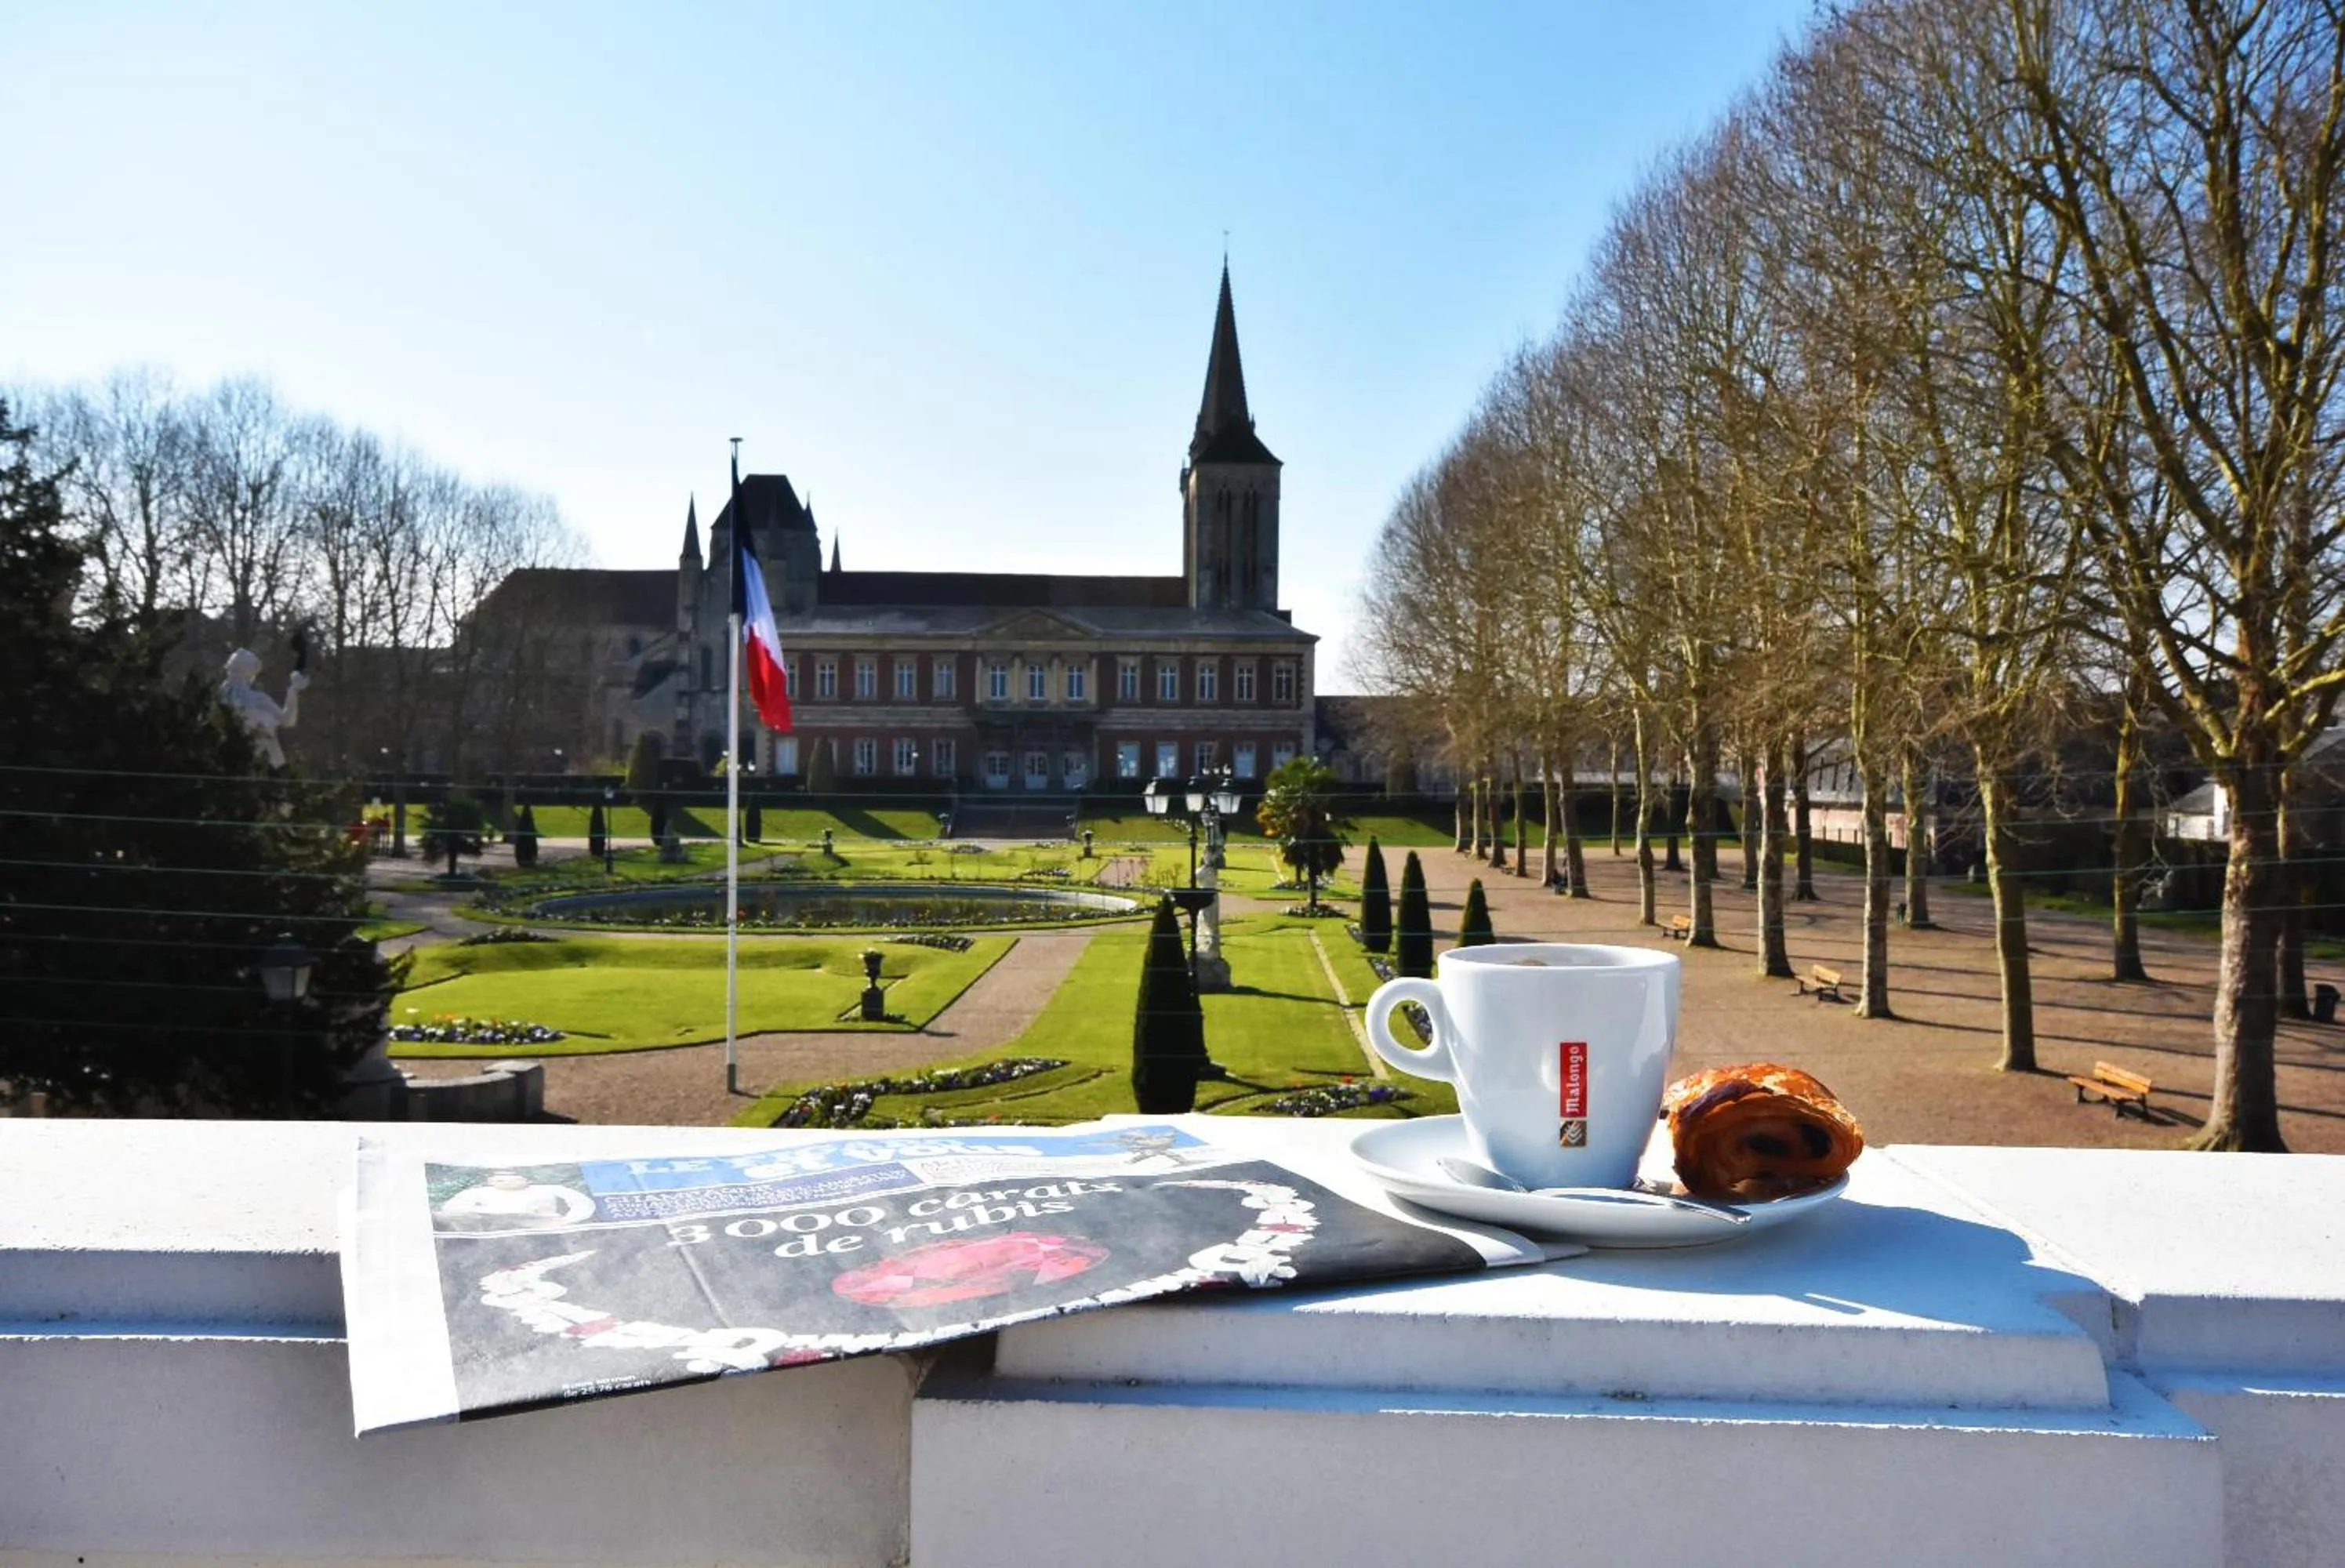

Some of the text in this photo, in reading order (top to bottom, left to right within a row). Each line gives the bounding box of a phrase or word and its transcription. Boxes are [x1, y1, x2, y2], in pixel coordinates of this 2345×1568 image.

[1566, 1046, 1584, 1113] Malongo
[775, 1198, 1075, 1258] de rubis
[909, 1179, 1123, 1218] carats
